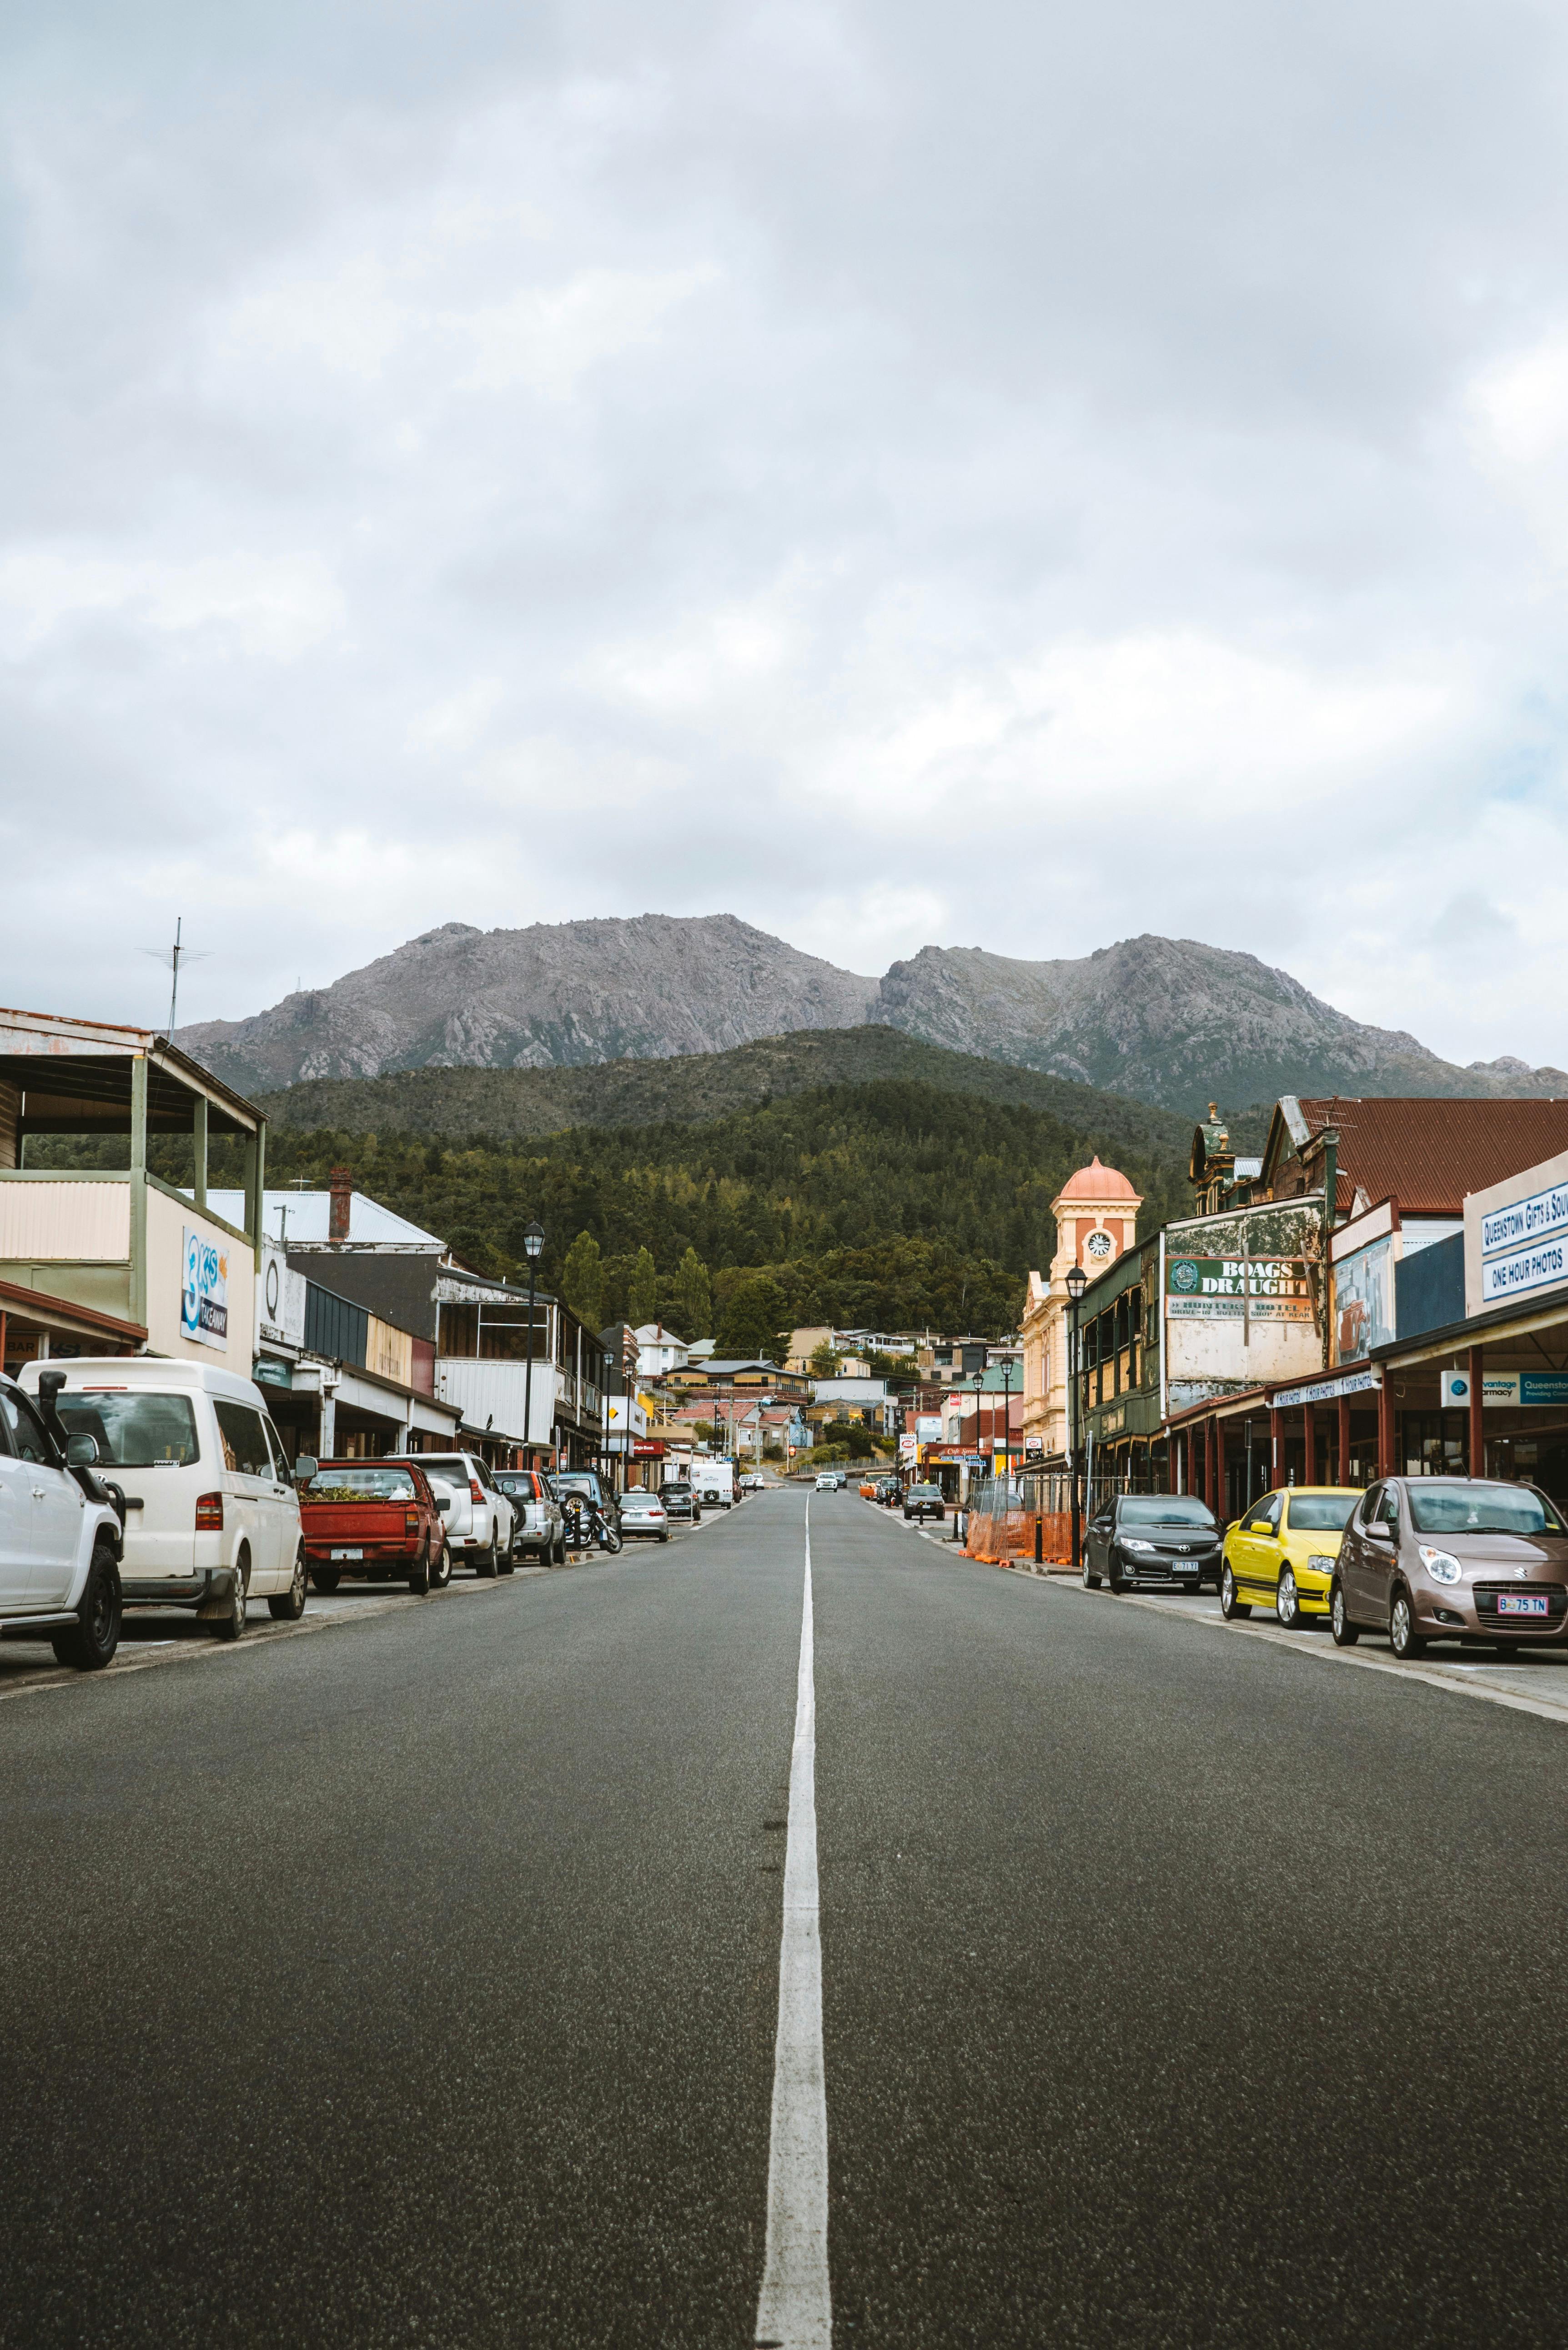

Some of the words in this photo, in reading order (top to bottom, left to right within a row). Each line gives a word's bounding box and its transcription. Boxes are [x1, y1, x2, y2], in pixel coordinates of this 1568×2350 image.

[1484, 1210, 1523, 1246] QUEENSTOWN
[1526, 1203, 1543, 1230] GIFTS
[1546, 1200, 1550, 1222] &
[1221, 1262, 1292, 1278] BOAGS
[1493, 1266, 1506, 1288] ONE
[1509, 1259, 1530, 1284] HOUR
[1532, 1247, 1563, 1277] PHOTOS
[1201, 1277, 1308, 1296] DRAUGHT
[201, 1303, 226, 1332] TAKEAWAY
[7, 1342, 35, 1352] BAR
[1483, 1381, 1517, 1389] vantage
[1501, 1599, 1506, 1609] B
[1517, 1599, 1528, 1610] 75
[1533, 1599, 1544, 1611] TN
